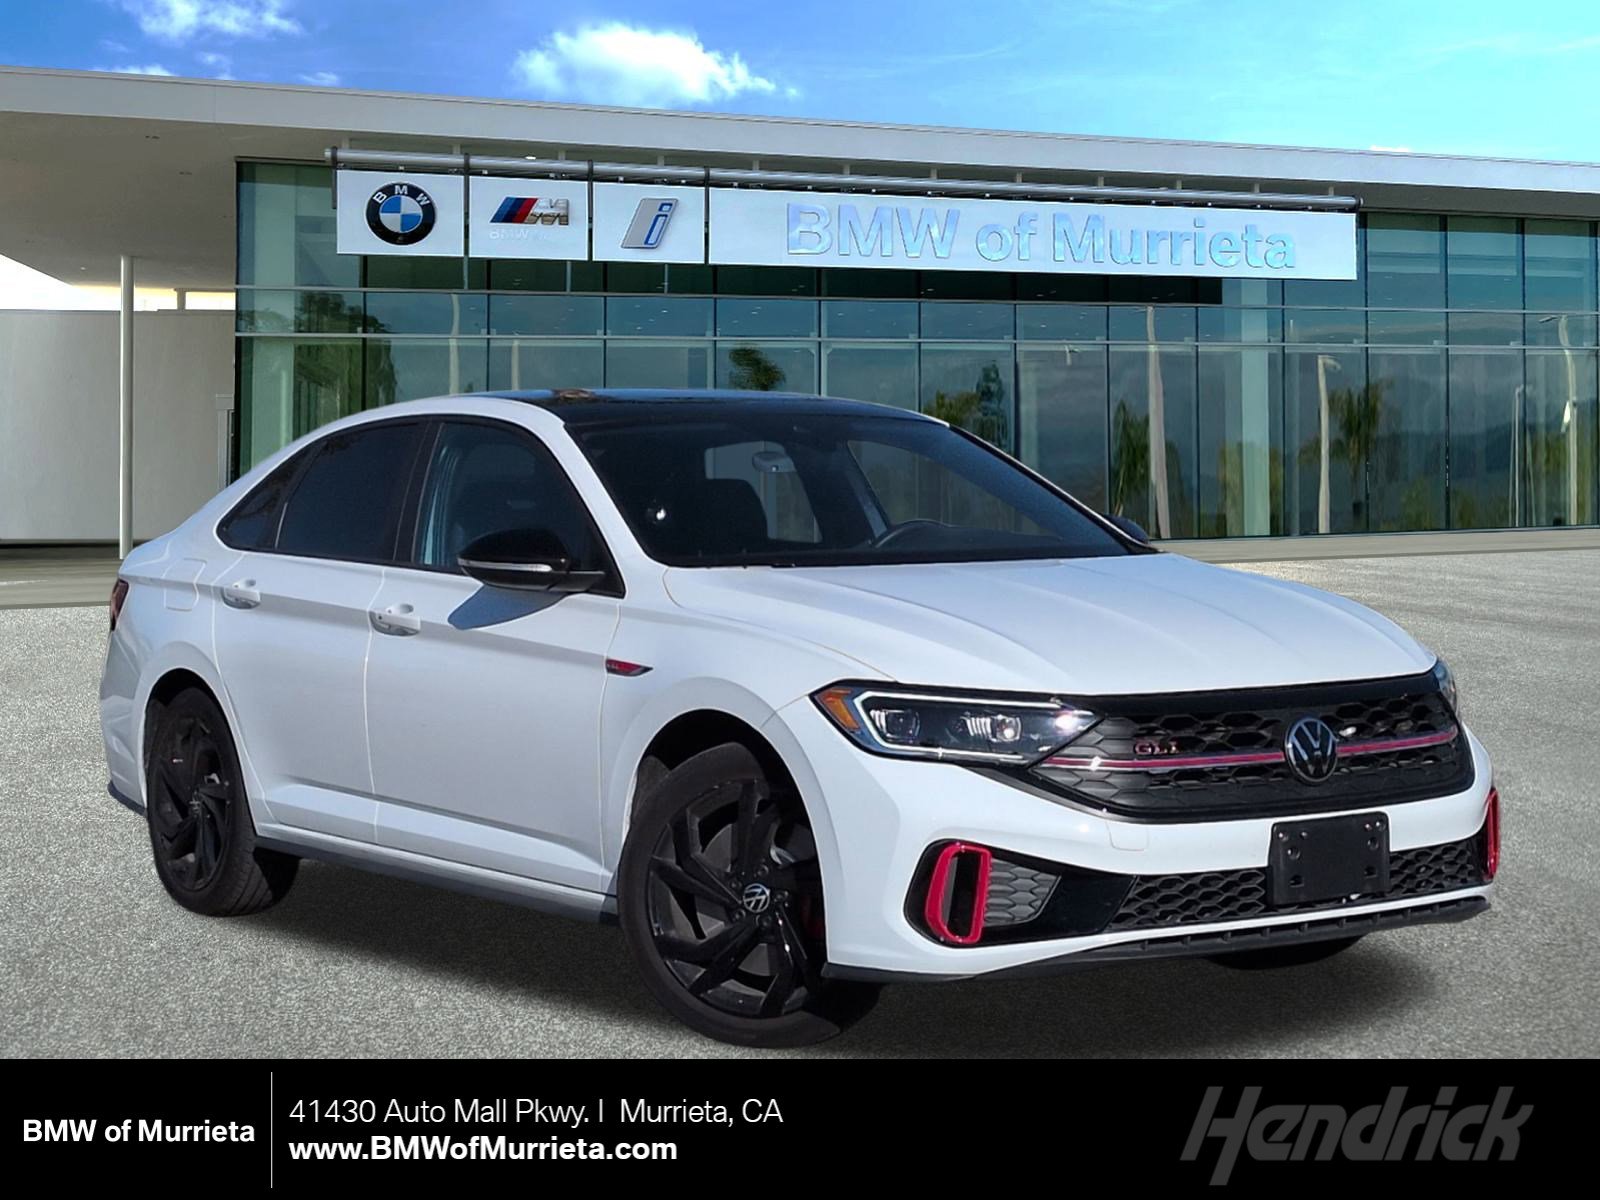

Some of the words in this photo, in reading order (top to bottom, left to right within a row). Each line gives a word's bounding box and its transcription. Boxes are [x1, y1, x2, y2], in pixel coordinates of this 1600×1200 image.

[371, 184, 431, 206] BMW
[786, 202, 961, 260] BMW
[975, 211, 1038, 262] of
[1053, 212, 1297, 270] Murrieta
